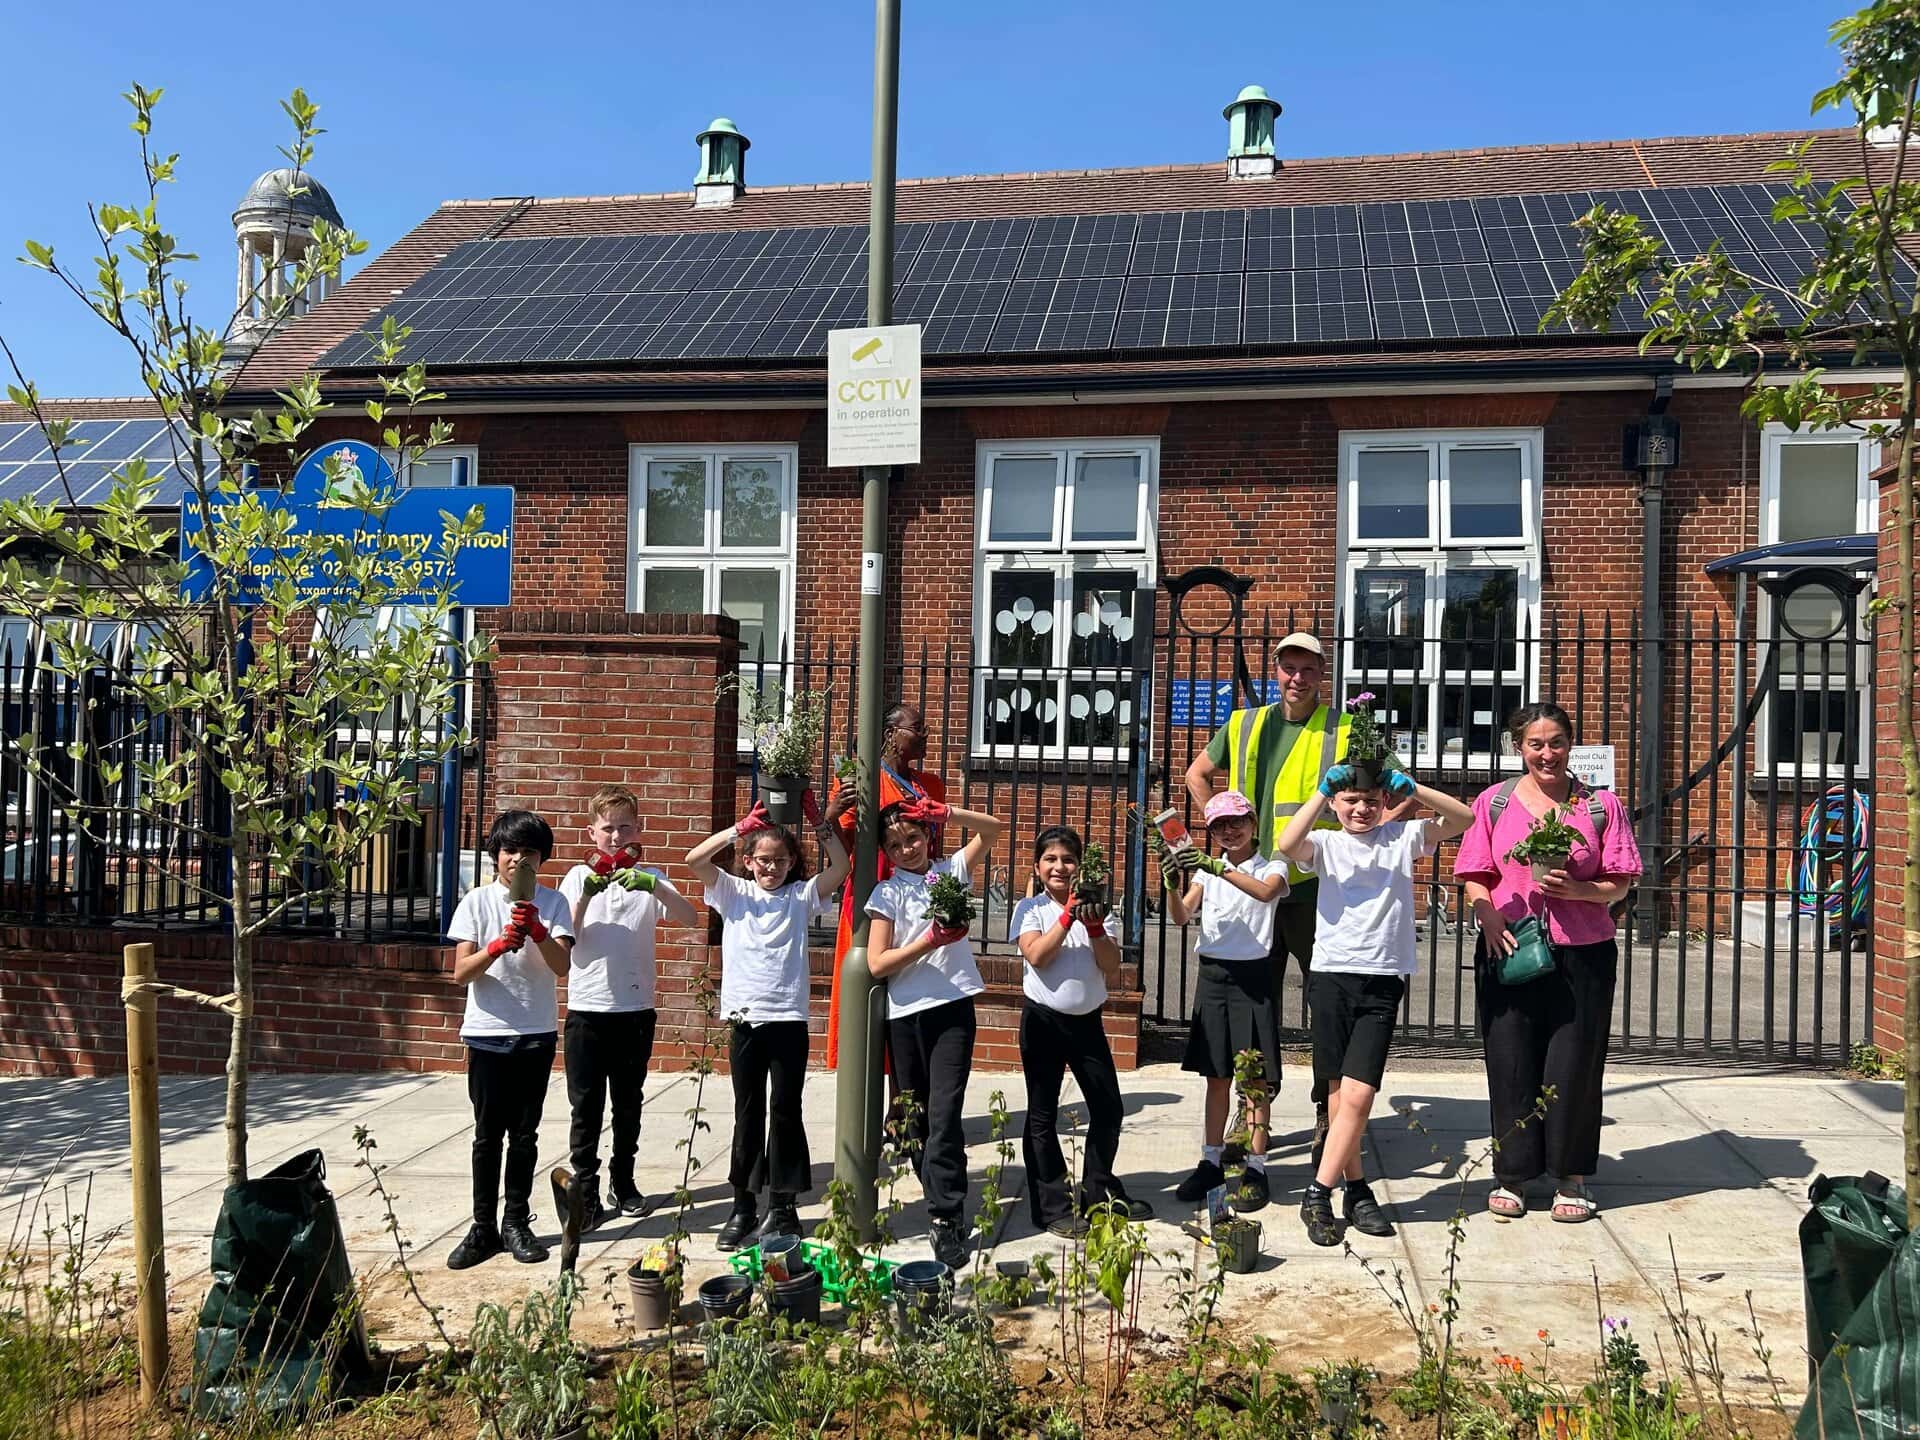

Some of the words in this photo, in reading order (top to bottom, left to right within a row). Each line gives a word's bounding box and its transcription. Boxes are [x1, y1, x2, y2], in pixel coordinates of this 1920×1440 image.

[837, 379, 911, 403] CCTV
[836, 410, 848, 420] in
[852, 407, 910, 420] operation
[186, 530, 257, 549] Wssx
[261, 529, 345, 549] ardns
[232, 560, 314, 581] elephe:
[322, 560, 353, 577] 02
[363, 560, 404, 577] 435
[412, 560, 456, 577] 9572
[867, 559, 874, 568] 9
